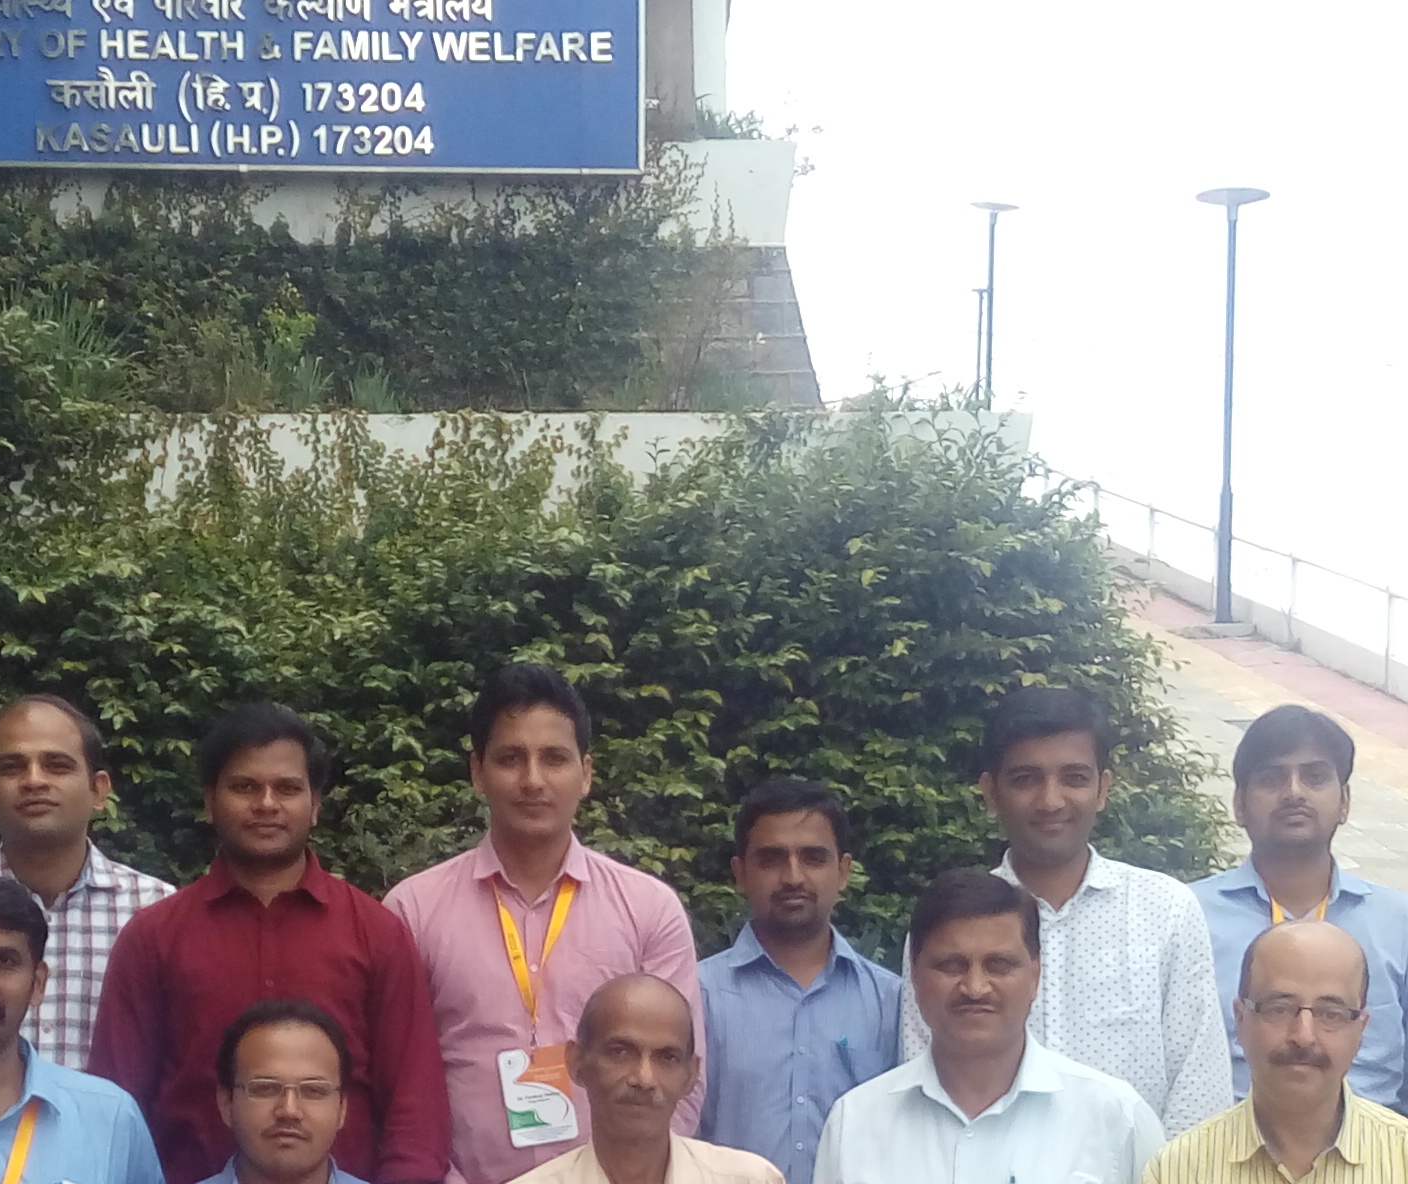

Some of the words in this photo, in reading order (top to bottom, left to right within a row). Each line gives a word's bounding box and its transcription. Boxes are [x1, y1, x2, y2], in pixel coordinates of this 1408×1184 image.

[93, 0, 135, 23] एव
[389, 0, 493, 21] मत्रालय
[39, 29, 88, 59] OF
[100, 29, 245, 61] HEALTH
[259, 33, 282, 61] &
[294, 30, 424, 62] FAMILY
[432, 31, 613, 62] WELFARE
[45, 66, 158, 111] कसौली
[301, 81, 426, 114] 173204
[36, 122, 200, 155] KASAULI
[210, 120, 301, 158] (H.P.)
[312, 125, 435, 156] 173204
